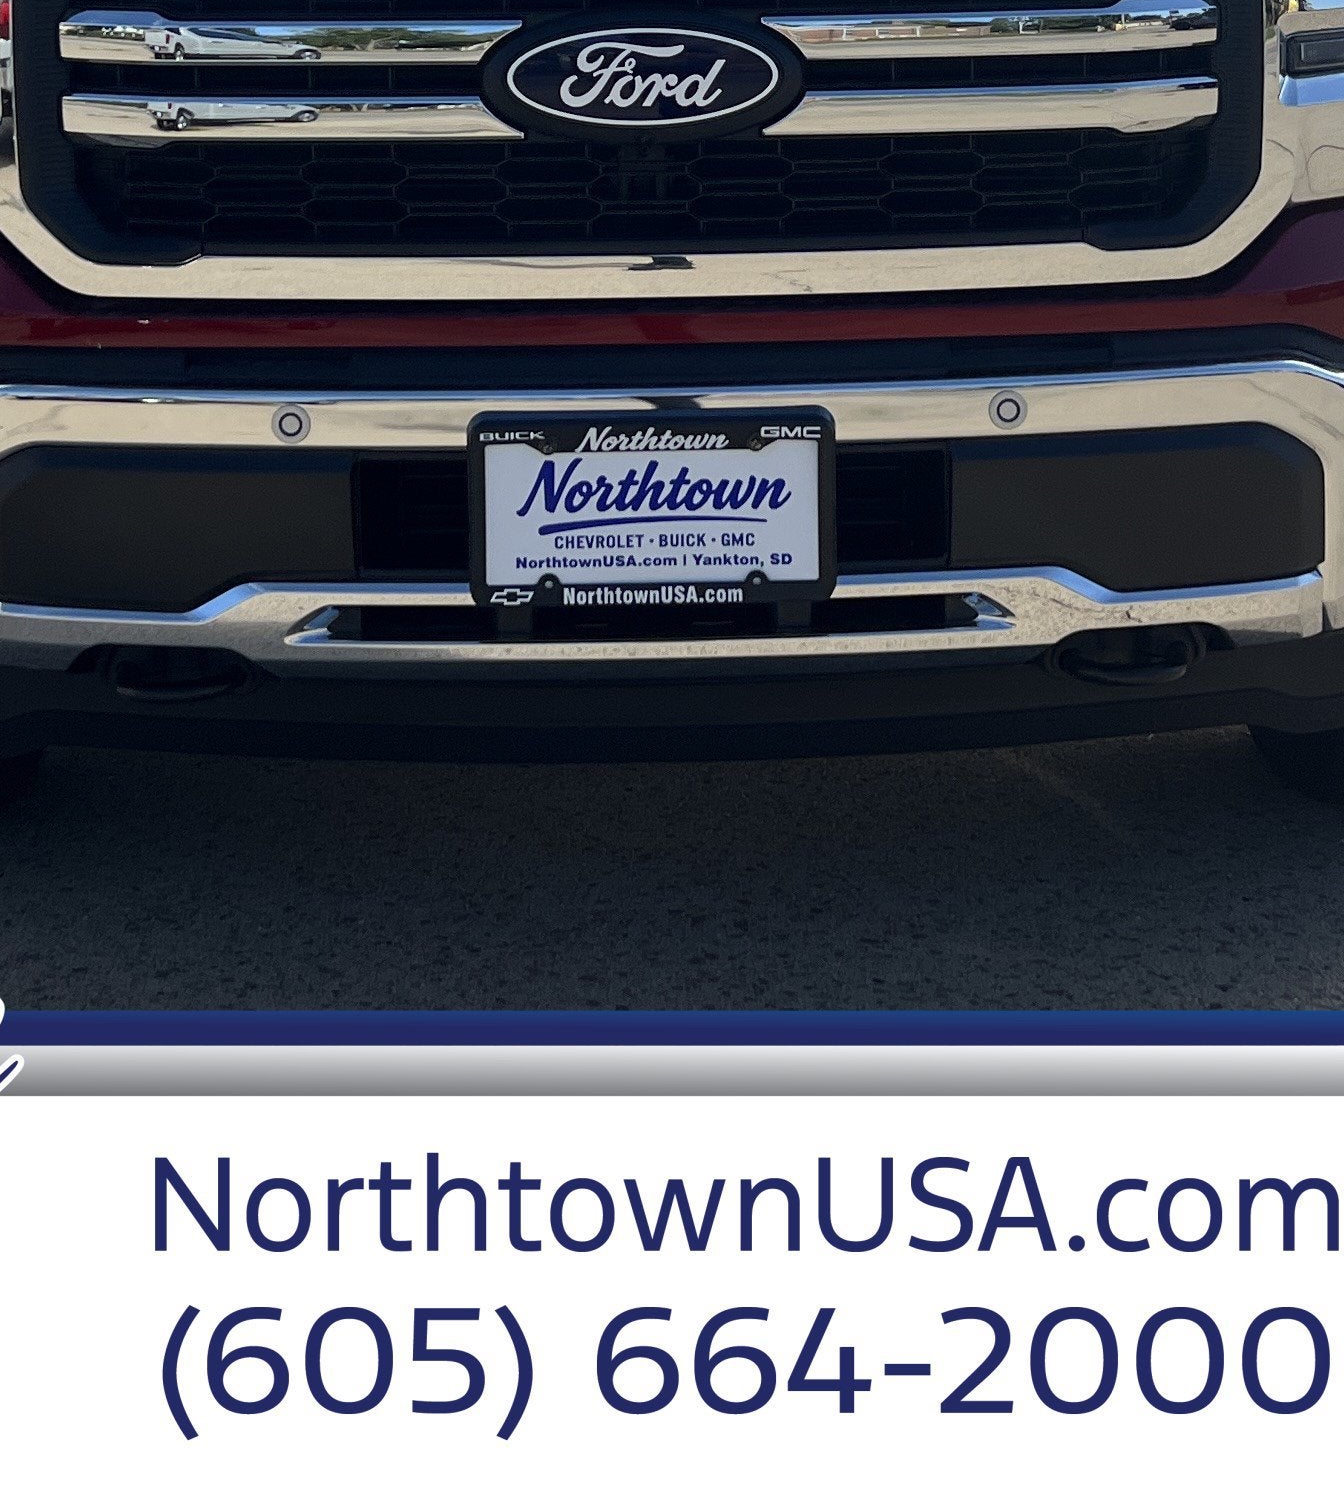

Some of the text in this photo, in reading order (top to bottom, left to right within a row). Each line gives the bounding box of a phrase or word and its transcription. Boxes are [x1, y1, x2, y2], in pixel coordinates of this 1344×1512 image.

[560, 42, 726, 108] Ford
[479, 431, 546, 442] BUICK
[574, 426, 730, 453] Northtown
[760, 426, 822, 438] GMC
[516, 457, 792, 517] Northtown
[554, 533, 755, 549] CHEVROLET BUICK GMC
[515, 552, 793, 569] NorthtownUSA.com Yankton, SD
[563, 585, 744, 605] NorthtownUSA.com
